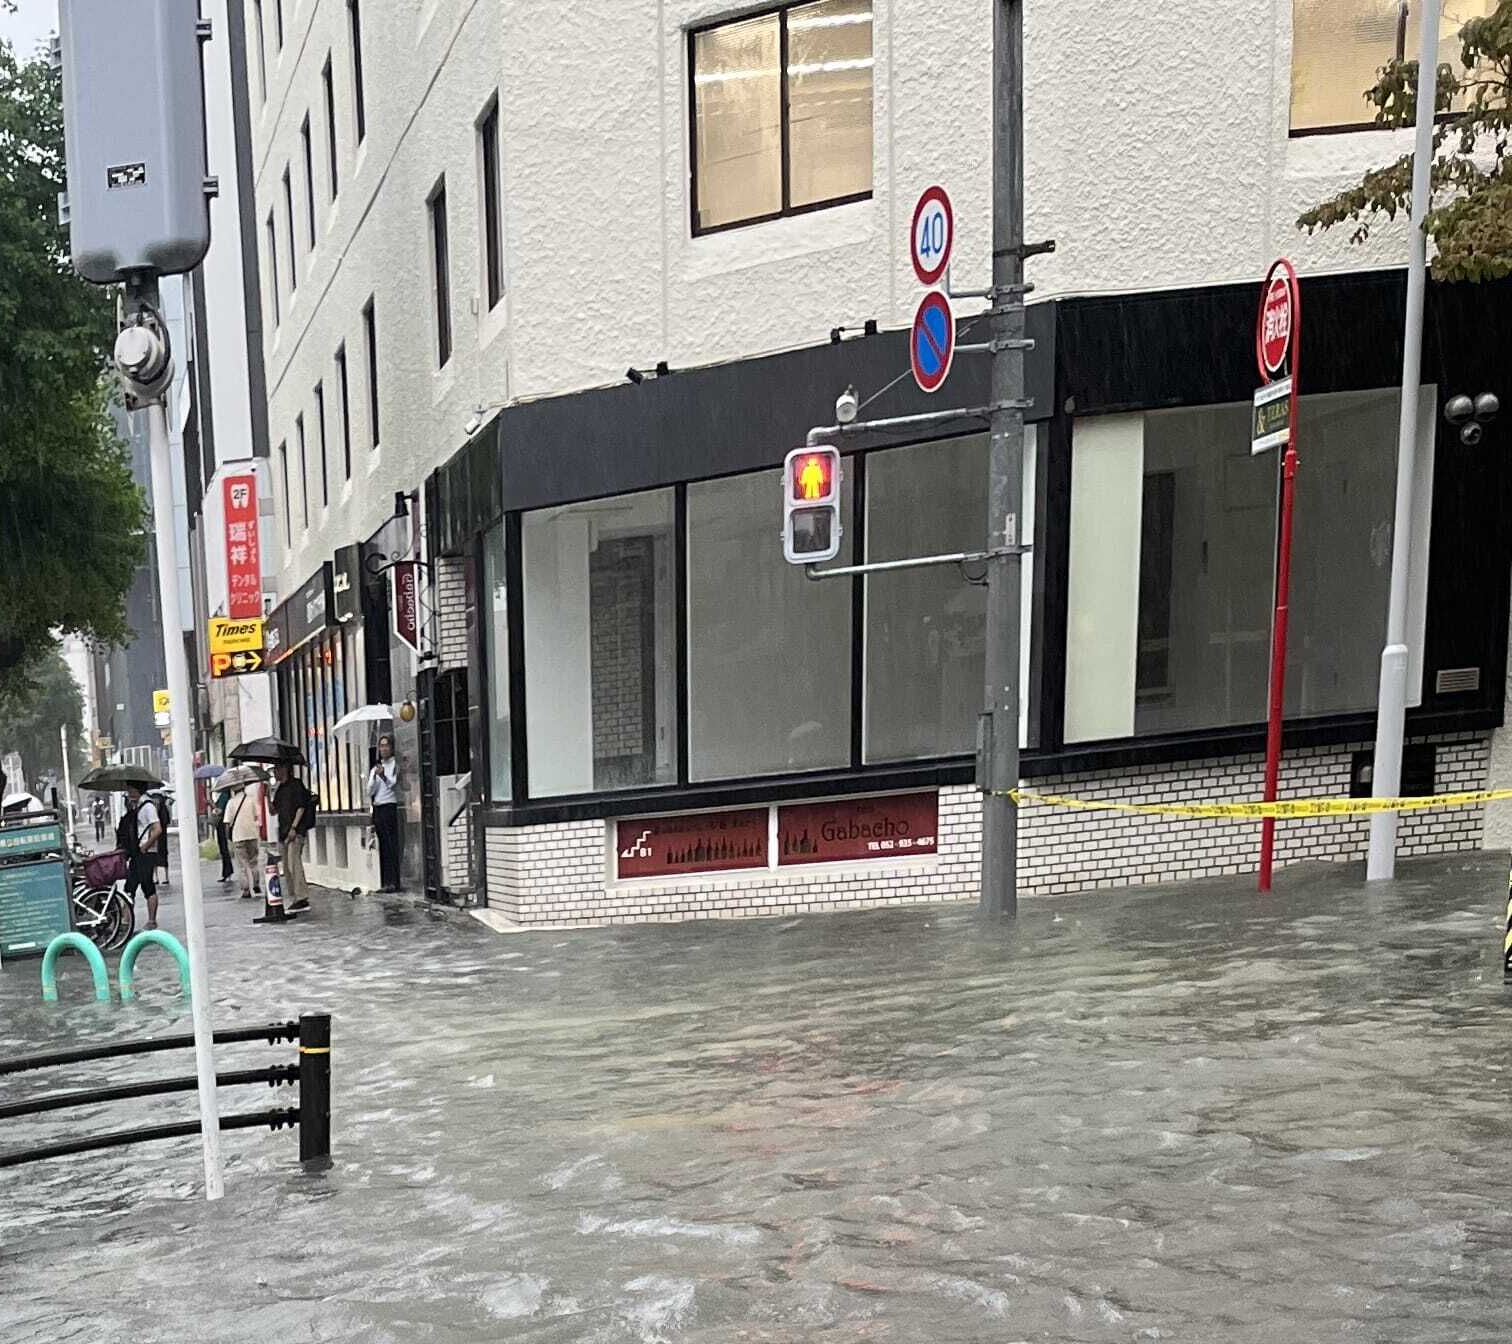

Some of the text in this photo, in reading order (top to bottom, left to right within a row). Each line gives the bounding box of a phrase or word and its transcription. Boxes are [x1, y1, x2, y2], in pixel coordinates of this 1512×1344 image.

[920, 212, 943, 257] 40
[1265, 302, 1288, 344] 消火栓
[233, 488, 248, 500] 2F
[232, 574, 257, 587] デンタル
[216, 623, 257, 637] Times
[821, 817, 910, 842] Gabacho
[867, 841, 881, 850] TEL
